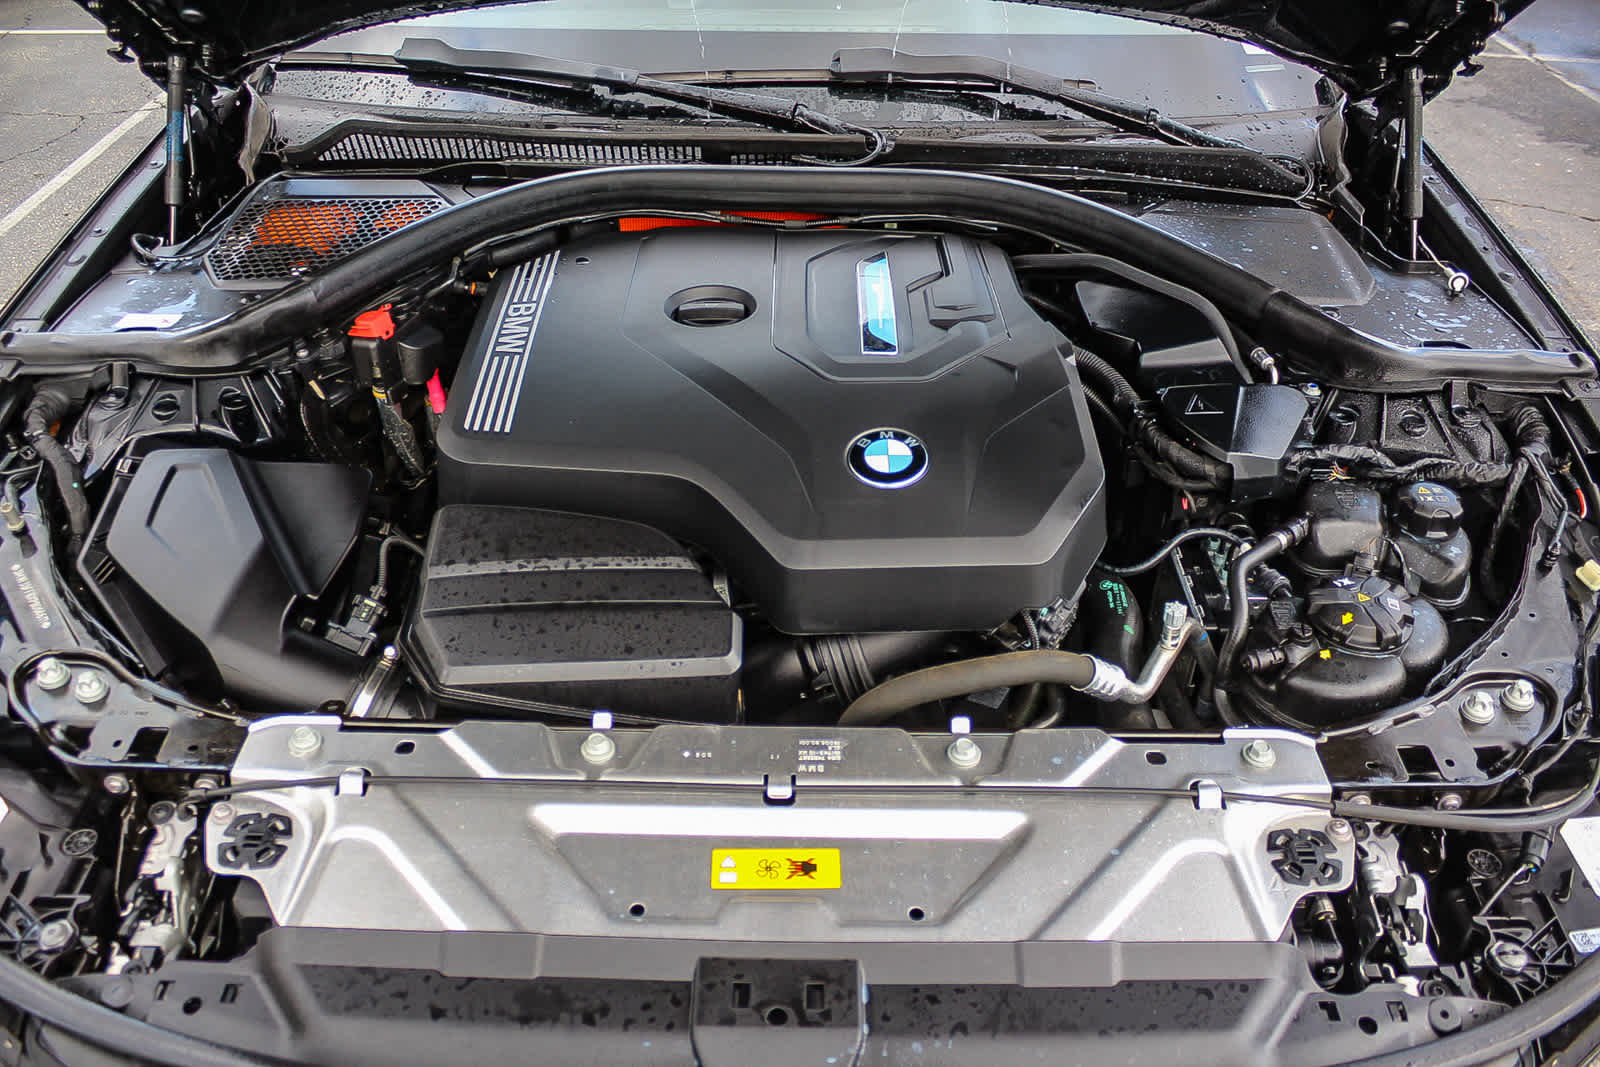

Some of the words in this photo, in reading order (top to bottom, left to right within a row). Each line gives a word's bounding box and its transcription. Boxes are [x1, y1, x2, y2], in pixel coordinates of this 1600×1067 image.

[495, 302, 537, 353] BMW
[856, 431, 920, 448] BMW
[798, 764, 824, 773] BMW
